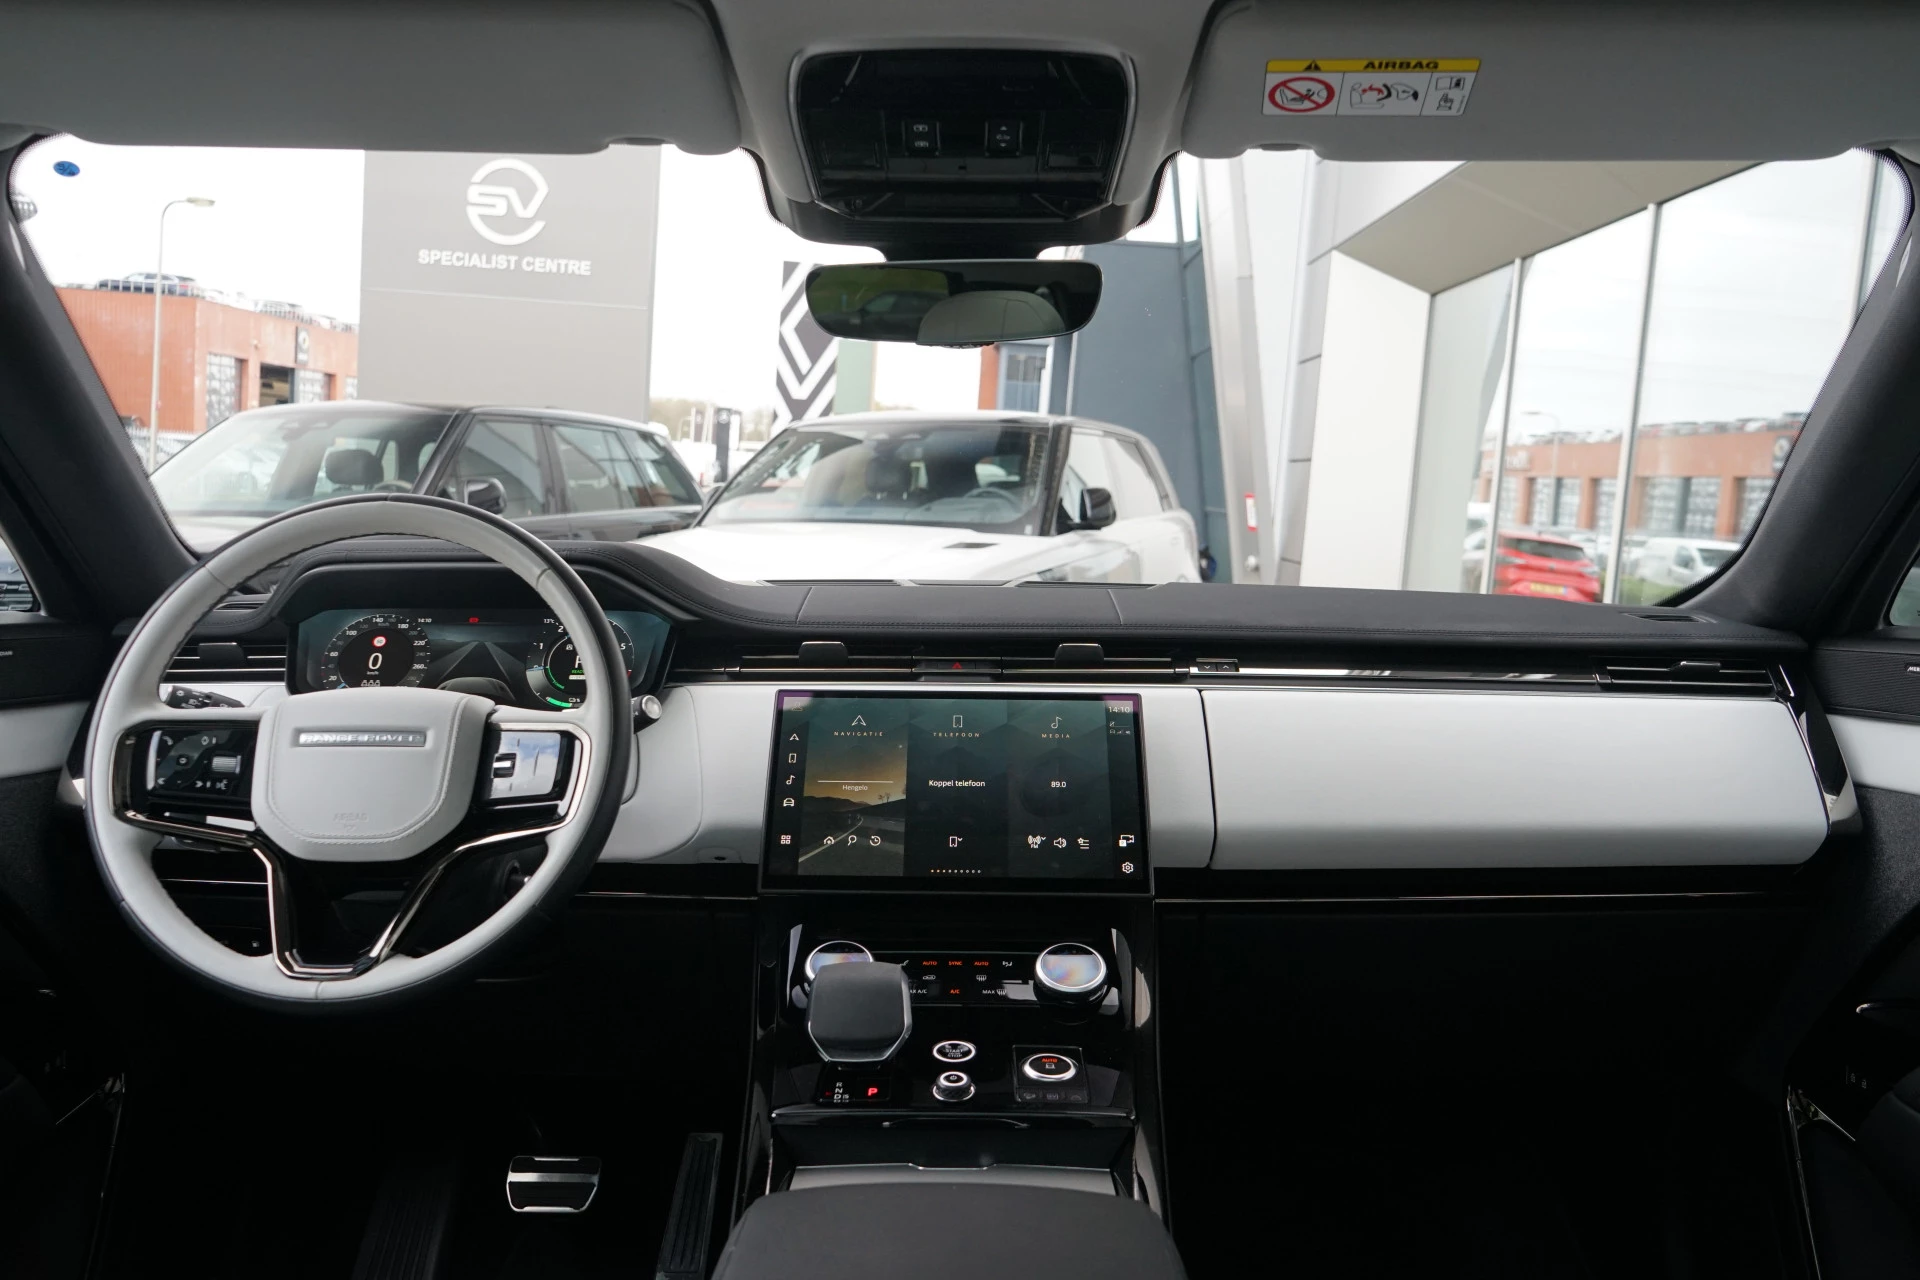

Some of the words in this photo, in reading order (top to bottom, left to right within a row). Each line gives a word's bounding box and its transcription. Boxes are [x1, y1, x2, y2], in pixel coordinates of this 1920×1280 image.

[1363, 61, 1440, 70] AIRBAG
[418, 248, 518, 270] SPECIALIST
[521, 256, 592, 275] CENTRE
[557, 625, 564, 633] 2
[368, 652, 383, 670] 0
[842, 784, 868, 792] Hengelo
[928, 779, 954, 788] Koppel
[955, 779, 986, 788] telefoon
[867, 1087, 878, 1096] P
